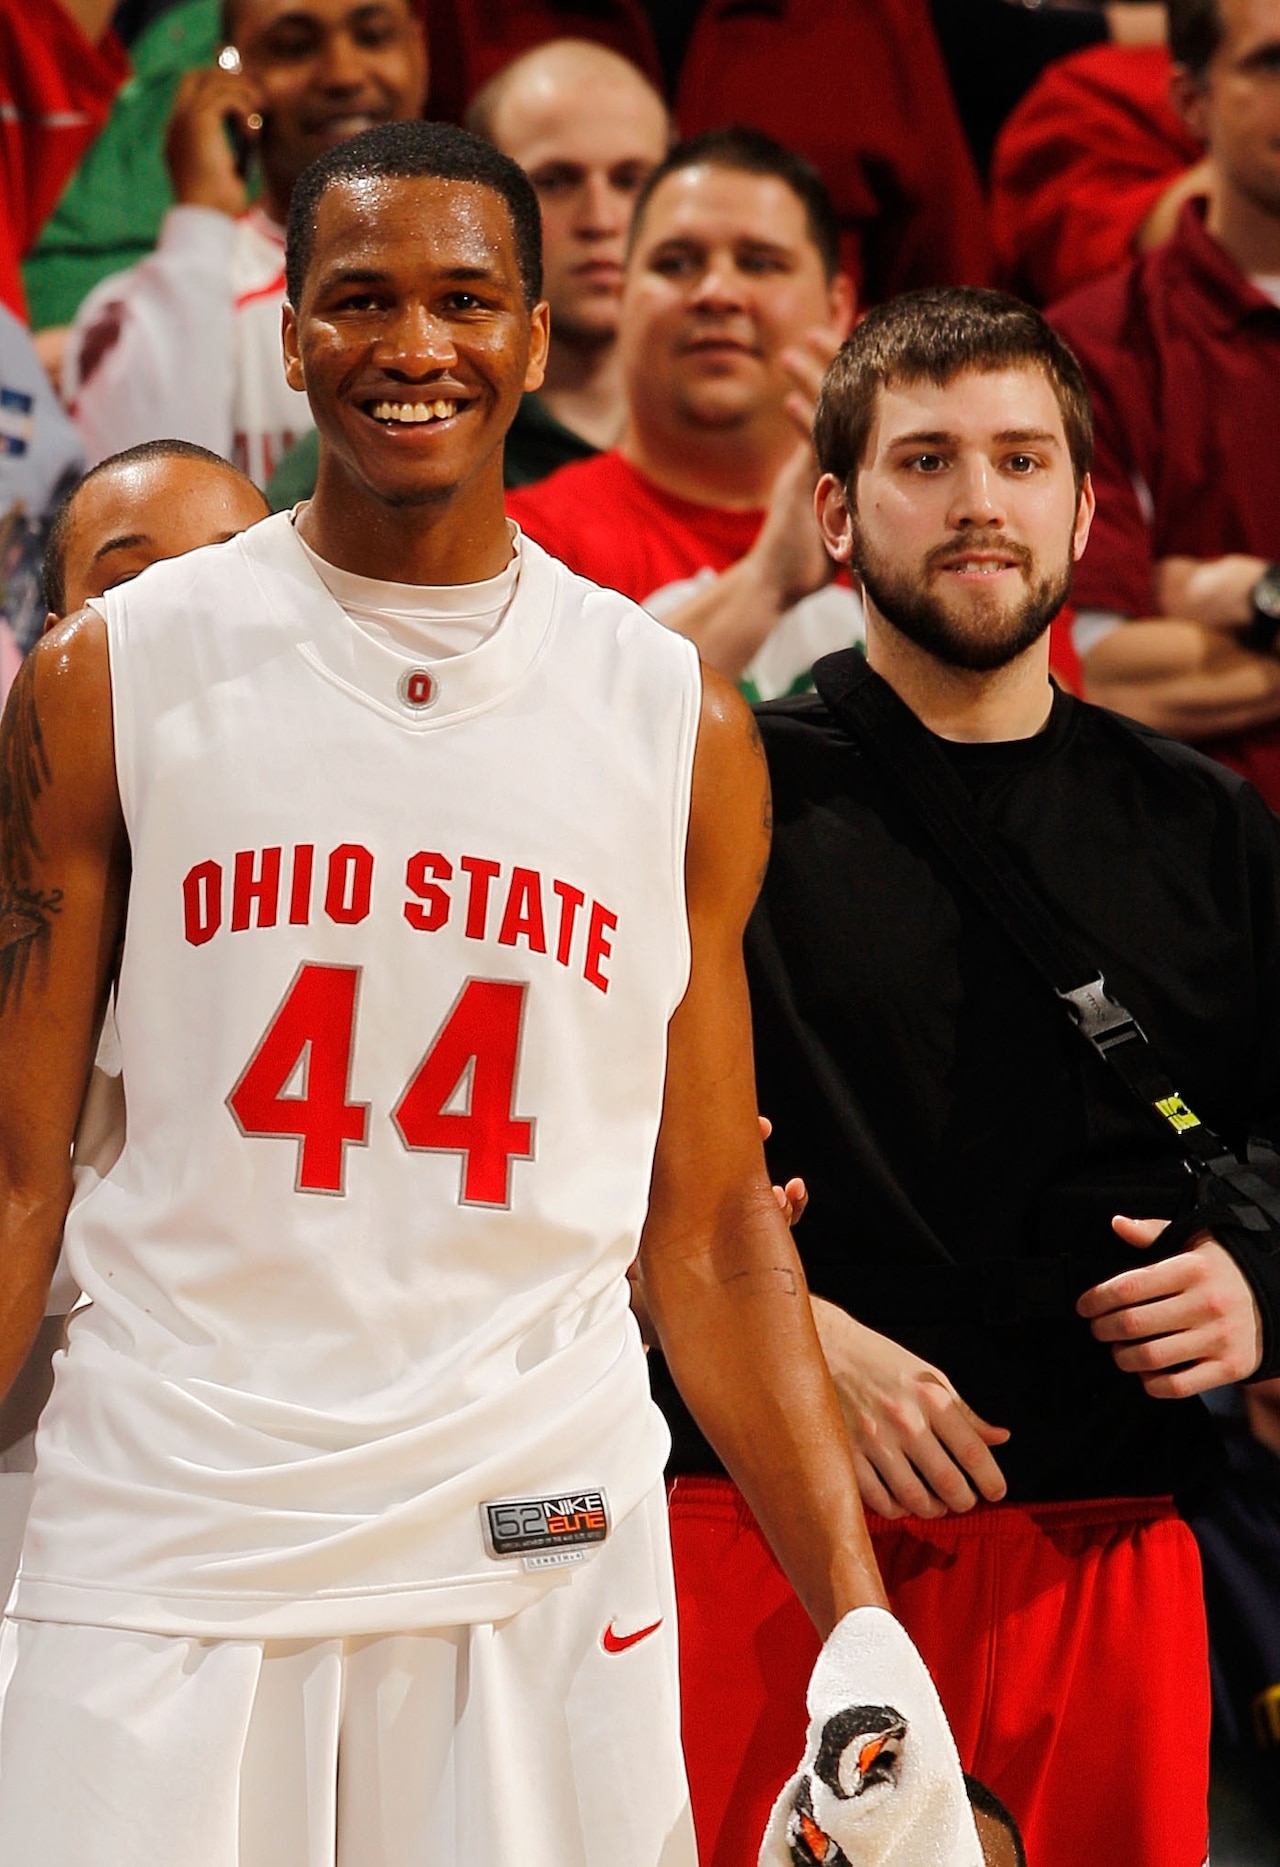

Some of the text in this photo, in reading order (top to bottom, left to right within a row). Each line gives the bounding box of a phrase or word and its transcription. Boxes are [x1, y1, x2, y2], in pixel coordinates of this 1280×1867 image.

[182, 843, 619, 995] OHIO STATE
[223, 959, 538, 1211] 44
[494, 1507, 546, 1537] 52
[543, 1494, 603, 1518] NIKE
